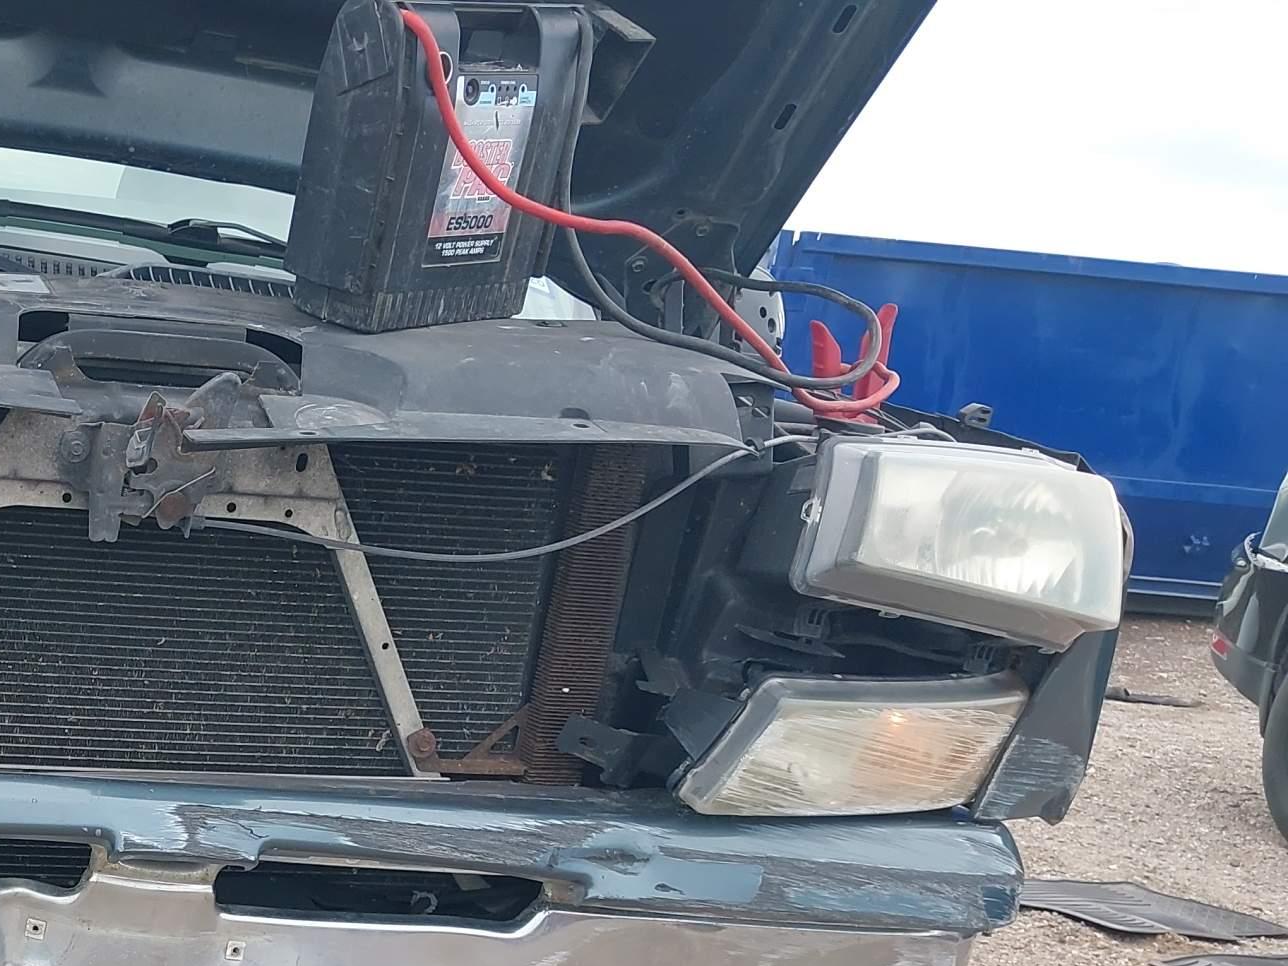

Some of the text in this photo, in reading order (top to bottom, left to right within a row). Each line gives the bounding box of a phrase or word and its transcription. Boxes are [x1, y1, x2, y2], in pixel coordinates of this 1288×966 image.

[446, 214, 494, 231] ES5000
[456, 240, 474, 248] POWER
[475, 239, 495, 247] SUPPLY
[442, 246, 484, 257] 1500 PEAK AMPS
